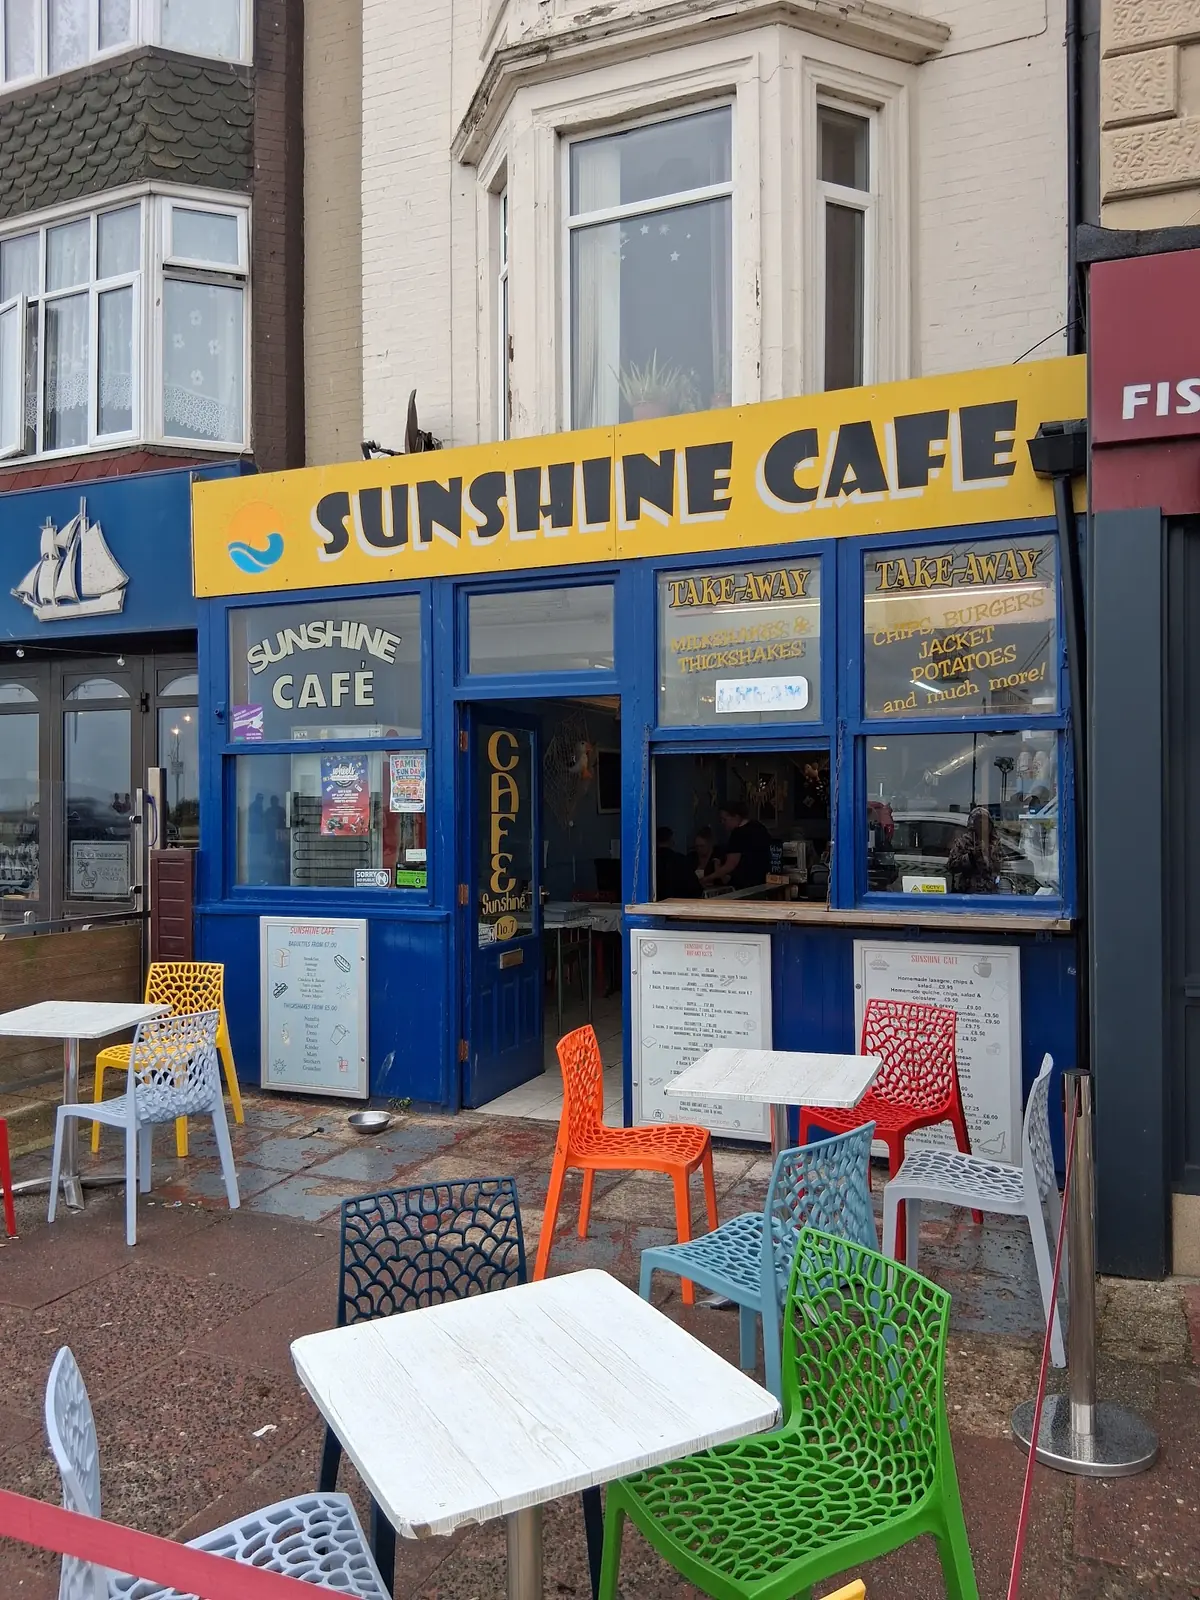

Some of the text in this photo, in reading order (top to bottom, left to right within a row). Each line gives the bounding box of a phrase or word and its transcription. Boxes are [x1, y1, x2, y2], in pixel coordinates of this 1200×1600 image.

[310, 400, 1018, 563] SUNSHINE CAFE
[668, 568, 811, 608] TAKE-AWAY
[875, 548, 1043, 591] TAKE-AWAY
[873, 589, 1044, 646] CHIPS, BURGERS
[246, 620, 402, 675] SUNSHINE
[671, 620, 790, 654] MILKSHAKES
[919, 625, 995, 659] JACKET
[678, 640, 807, 674] THICKSHAKES
[911, 644, 1017, 682] POTATOES
[272, 661, 374, 709] CAFÉ
[883, 662, 1046, 714] and much more!
[395, 760, 421, 768] FAMILY
[487, 730, 520, 893] CAFE
[482, 892, 526, 914] Sunshine
[290, 926, 335, 936] SUNSHINE CAFE
[497, 920, 514, 936] No.7
[911, 954, 940, 964] SUNSHINE
